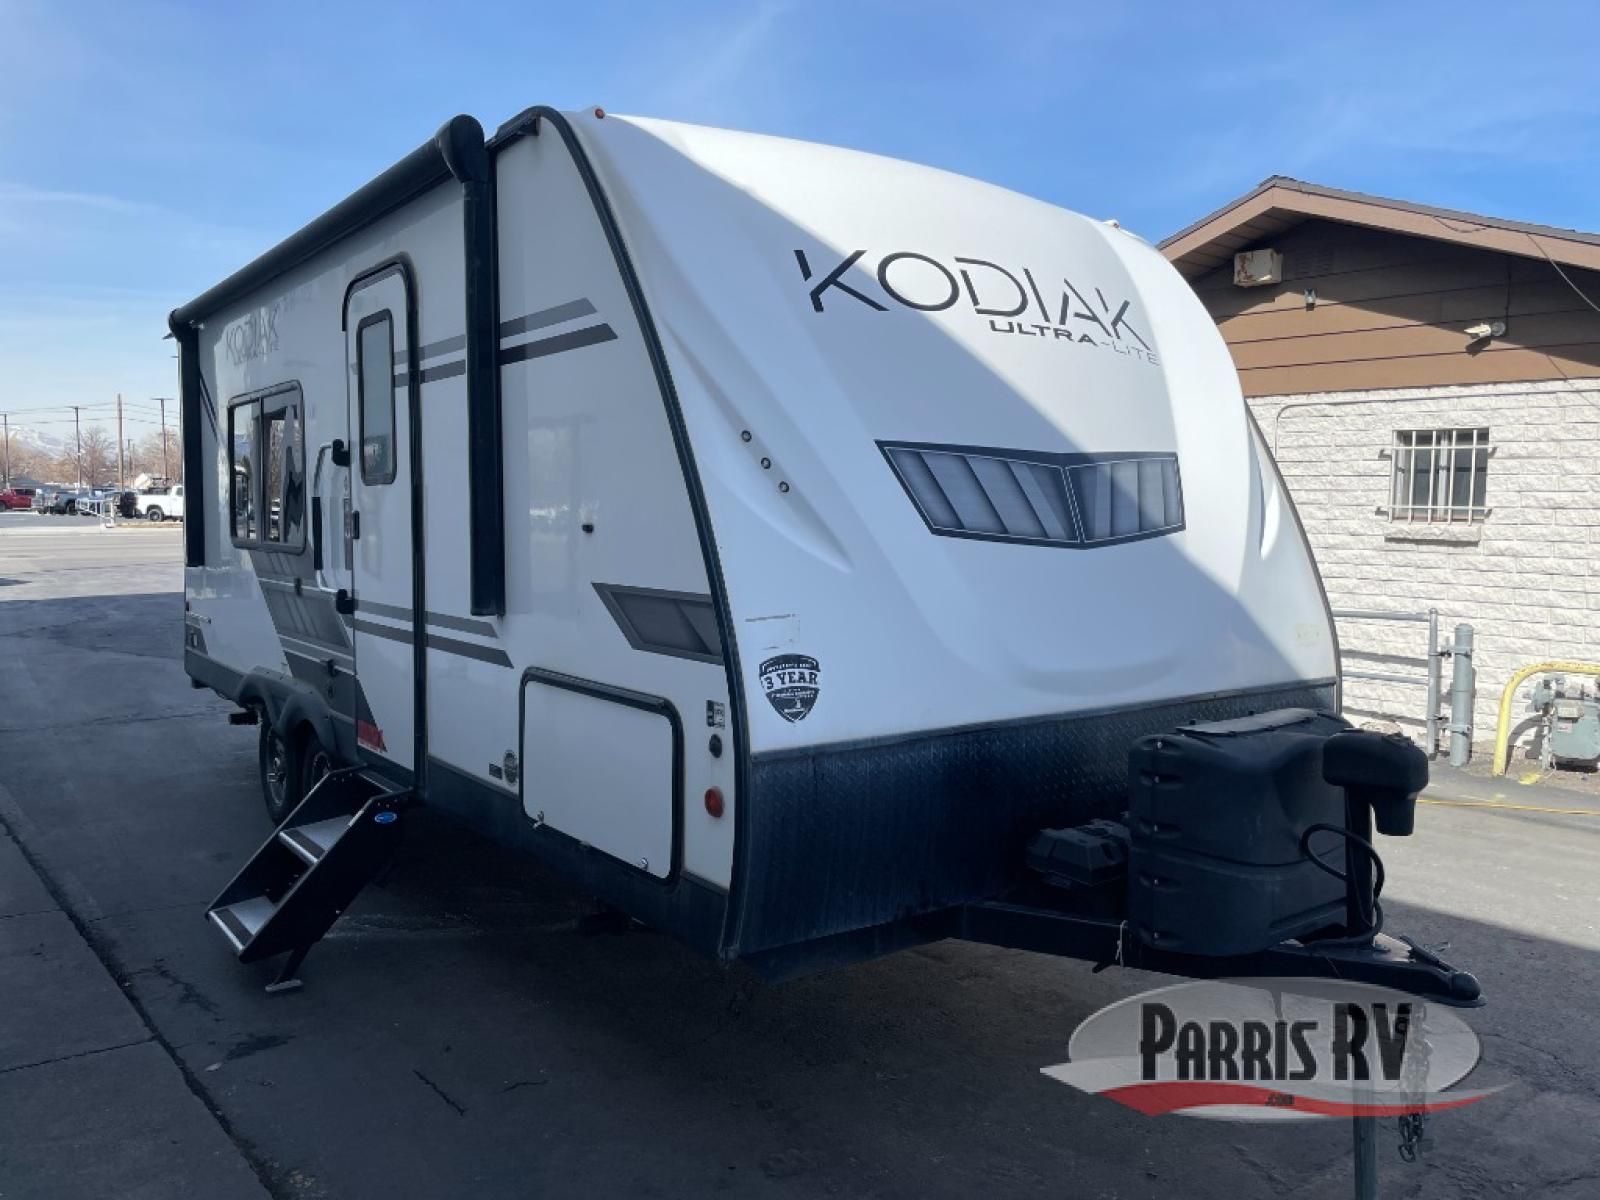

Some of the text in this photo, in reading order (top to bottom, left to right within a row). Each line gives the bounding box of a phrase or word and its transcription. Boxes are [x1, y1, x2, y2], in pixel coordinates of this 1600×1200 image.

[794, 250, 1151, 351] KODIAK
[988, 319, 1160, 366] ULTRA-LITE
[764, 671, 818, 690] 3 YEAR
